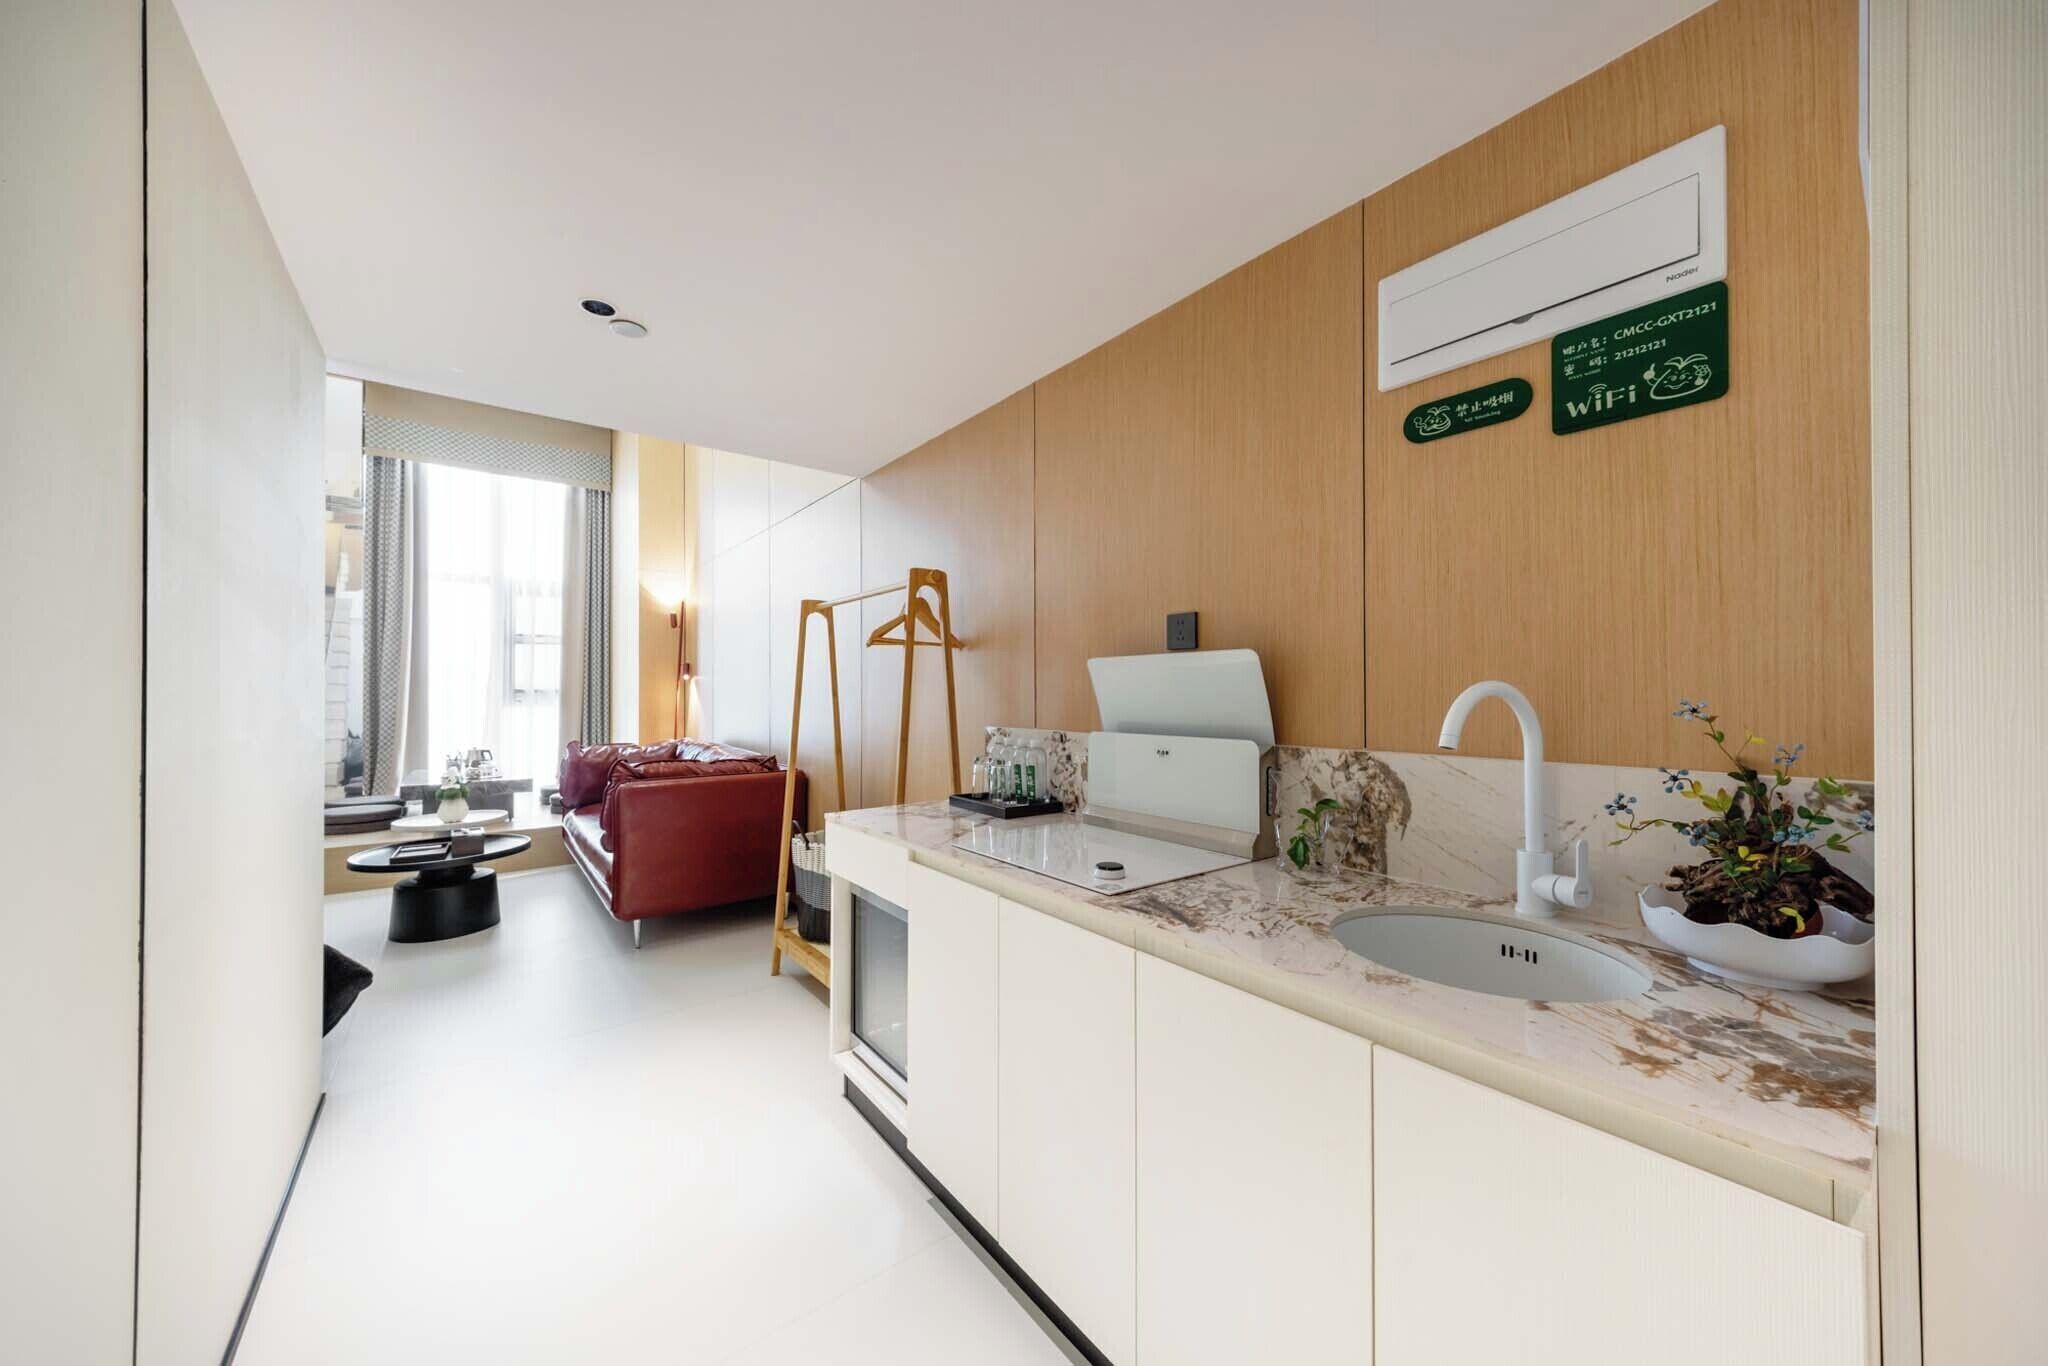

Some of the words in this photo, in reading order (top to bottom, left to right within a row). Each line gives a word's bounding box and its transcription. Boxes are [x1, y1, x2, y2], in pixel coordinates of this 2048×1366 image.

[1614, 301, 1716, 340] CMCC-GXT2121
[1614, 338, 1666, 360] 21212121
[1456, 391, 1513, 417] 禁止吸烟
